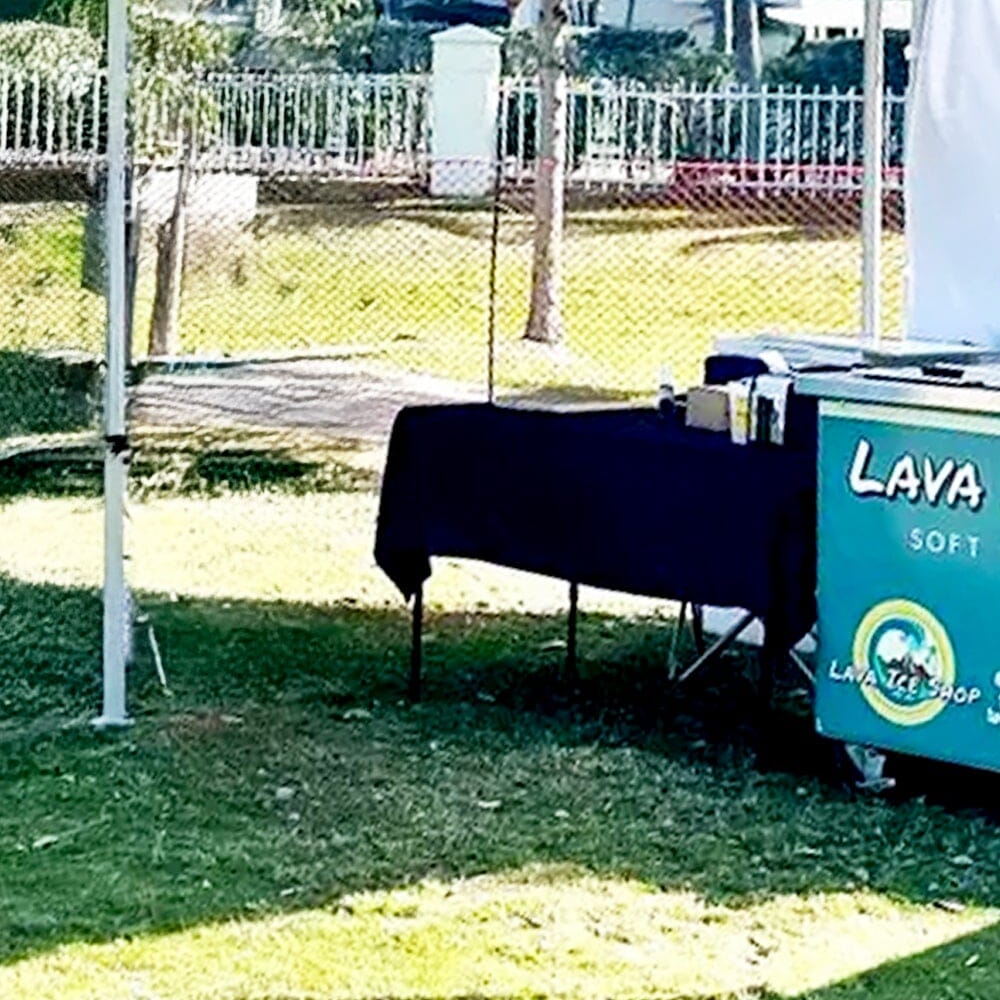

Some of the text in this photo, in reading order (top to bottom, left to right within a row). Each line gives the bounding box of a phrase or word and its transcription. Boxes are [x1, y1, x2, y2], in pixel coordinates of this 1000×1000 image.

[848, 438, 984, 508] LAVA
[909, 527, 981, 559] SOFT
[828, 660, 982, 704] LAVA ICE SHOP
